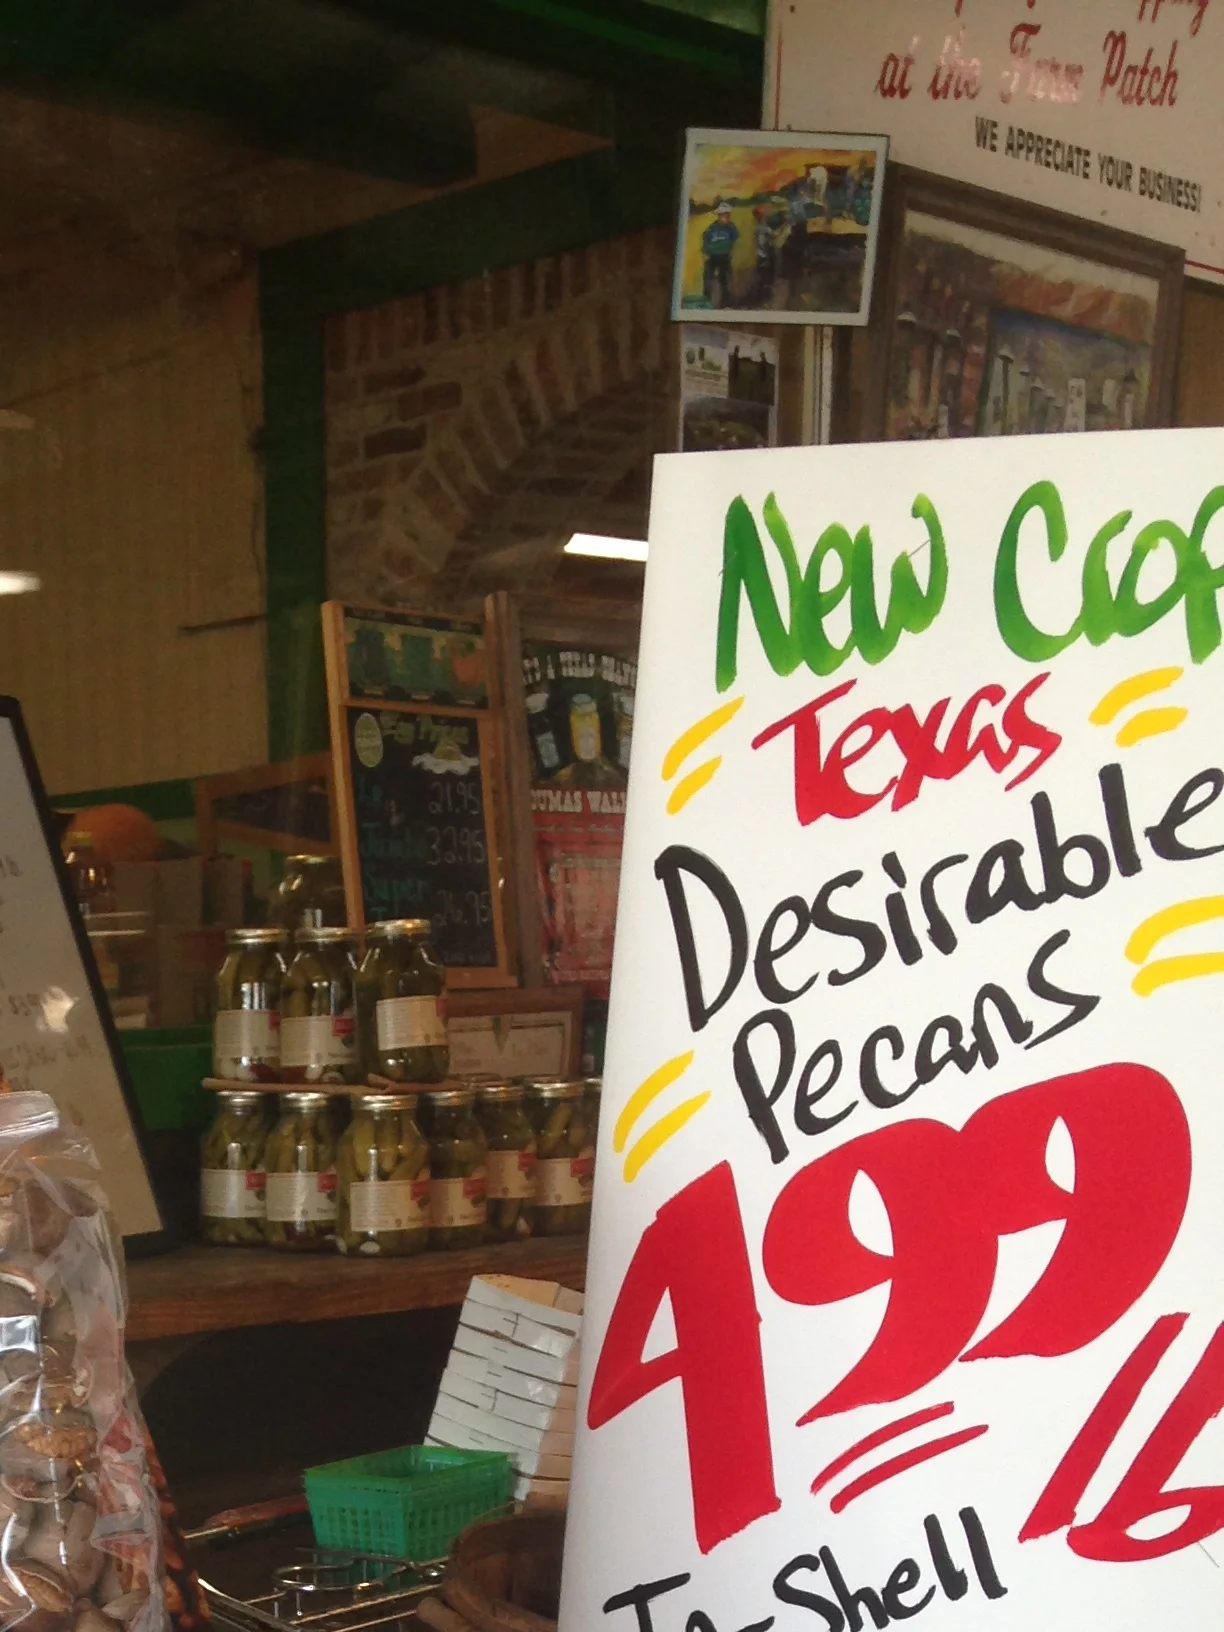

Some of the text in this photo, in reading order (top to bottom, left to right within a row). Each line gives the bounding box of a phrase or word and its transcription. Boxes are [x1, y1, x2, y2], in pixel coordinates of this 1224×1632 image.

[1100, 30, 1179, 107] Patch
[975, 115, 1203, 213] WE APPRECIATE YOUR BUSINESS!
[715, 491, 948, 693] New
[751, 671, 1063, 827] Texas
[654, 762, 1224, 1032] Desirable
[733, 929, 1101, 1165] Pecans
